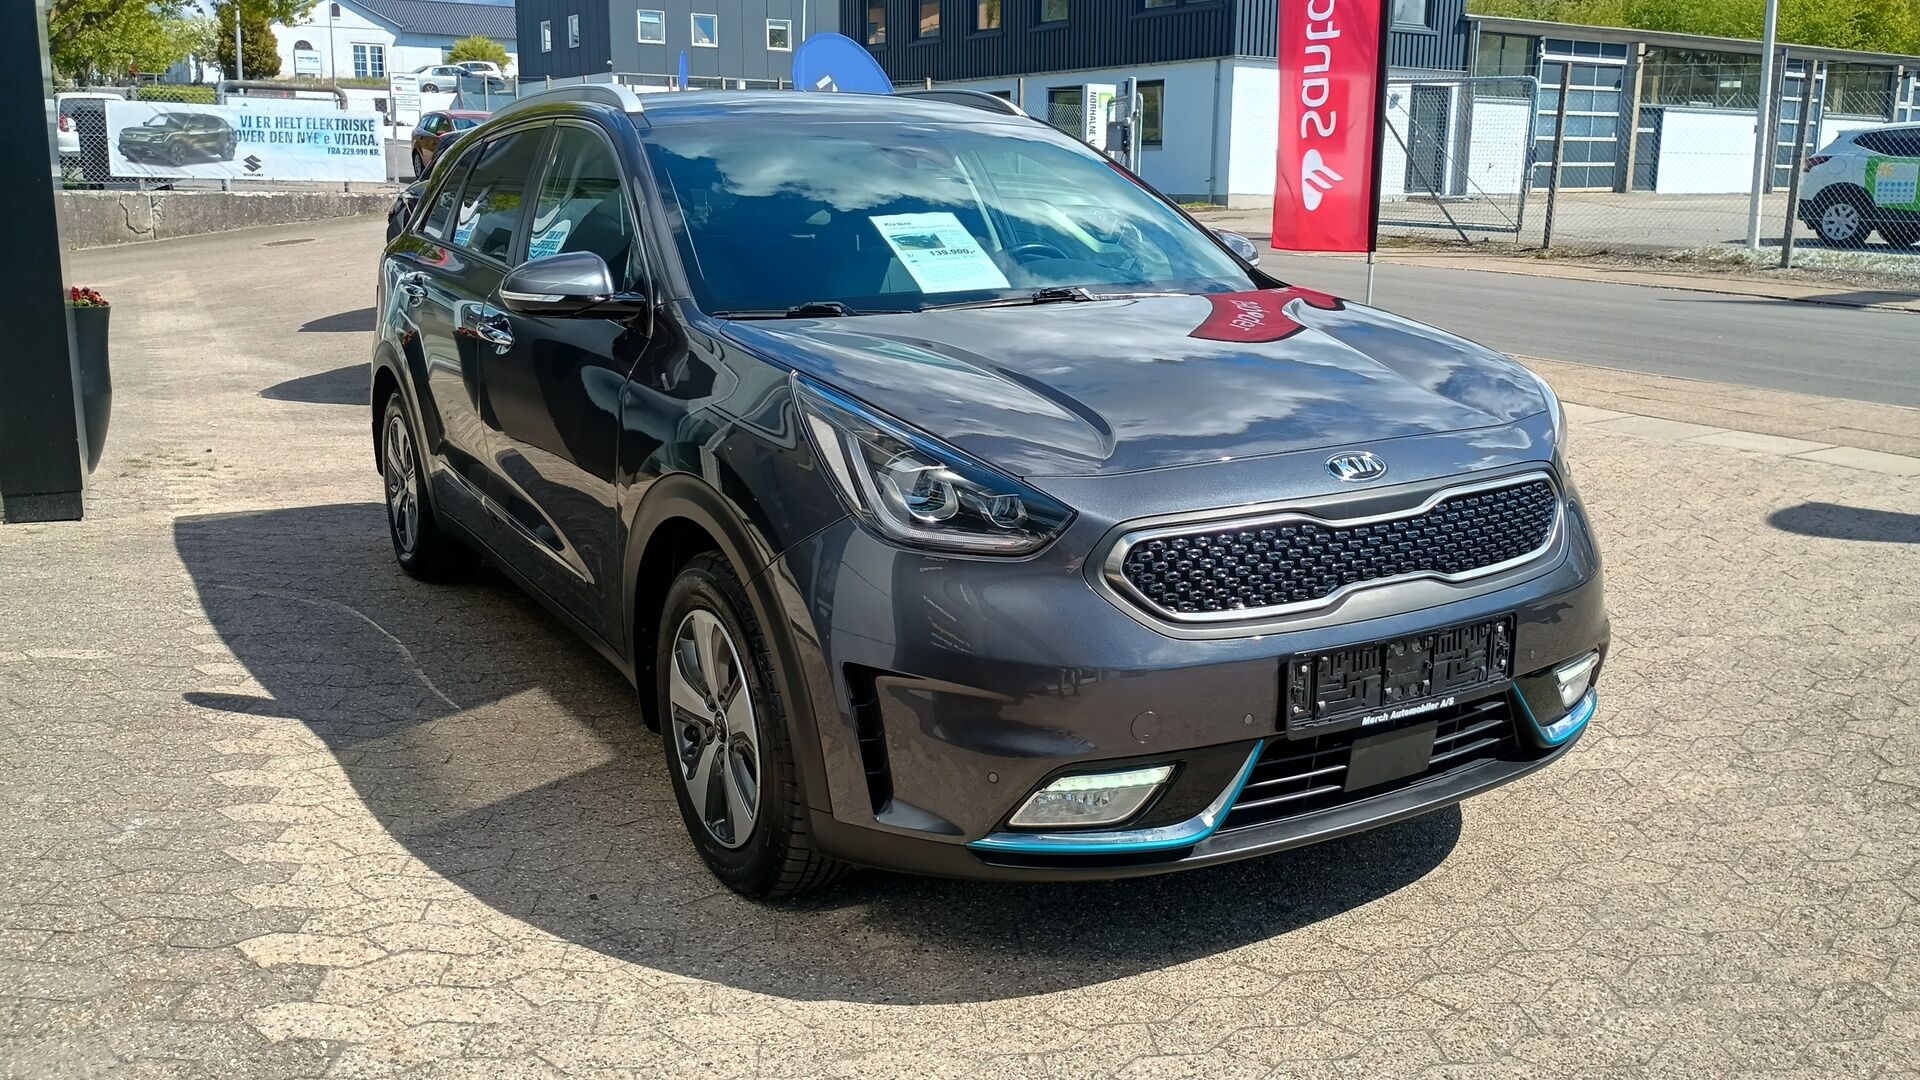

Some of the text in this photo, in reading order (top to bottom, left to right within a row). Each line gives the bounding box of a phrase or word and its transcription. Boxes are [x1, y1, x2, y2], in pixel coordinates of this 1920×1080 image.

[240, 115, 375, 132] VI ER HELT ELEKTRISKE
[235, 130, 379, 146] OVER DEN NYE e VITARA.
[327, 147, 341, 155] FRA
[1333, 455, 1382, 475] KIA
[1390, 702, 1439, 720] Automobiler
[1440, 697, 1455, 709] A/S
